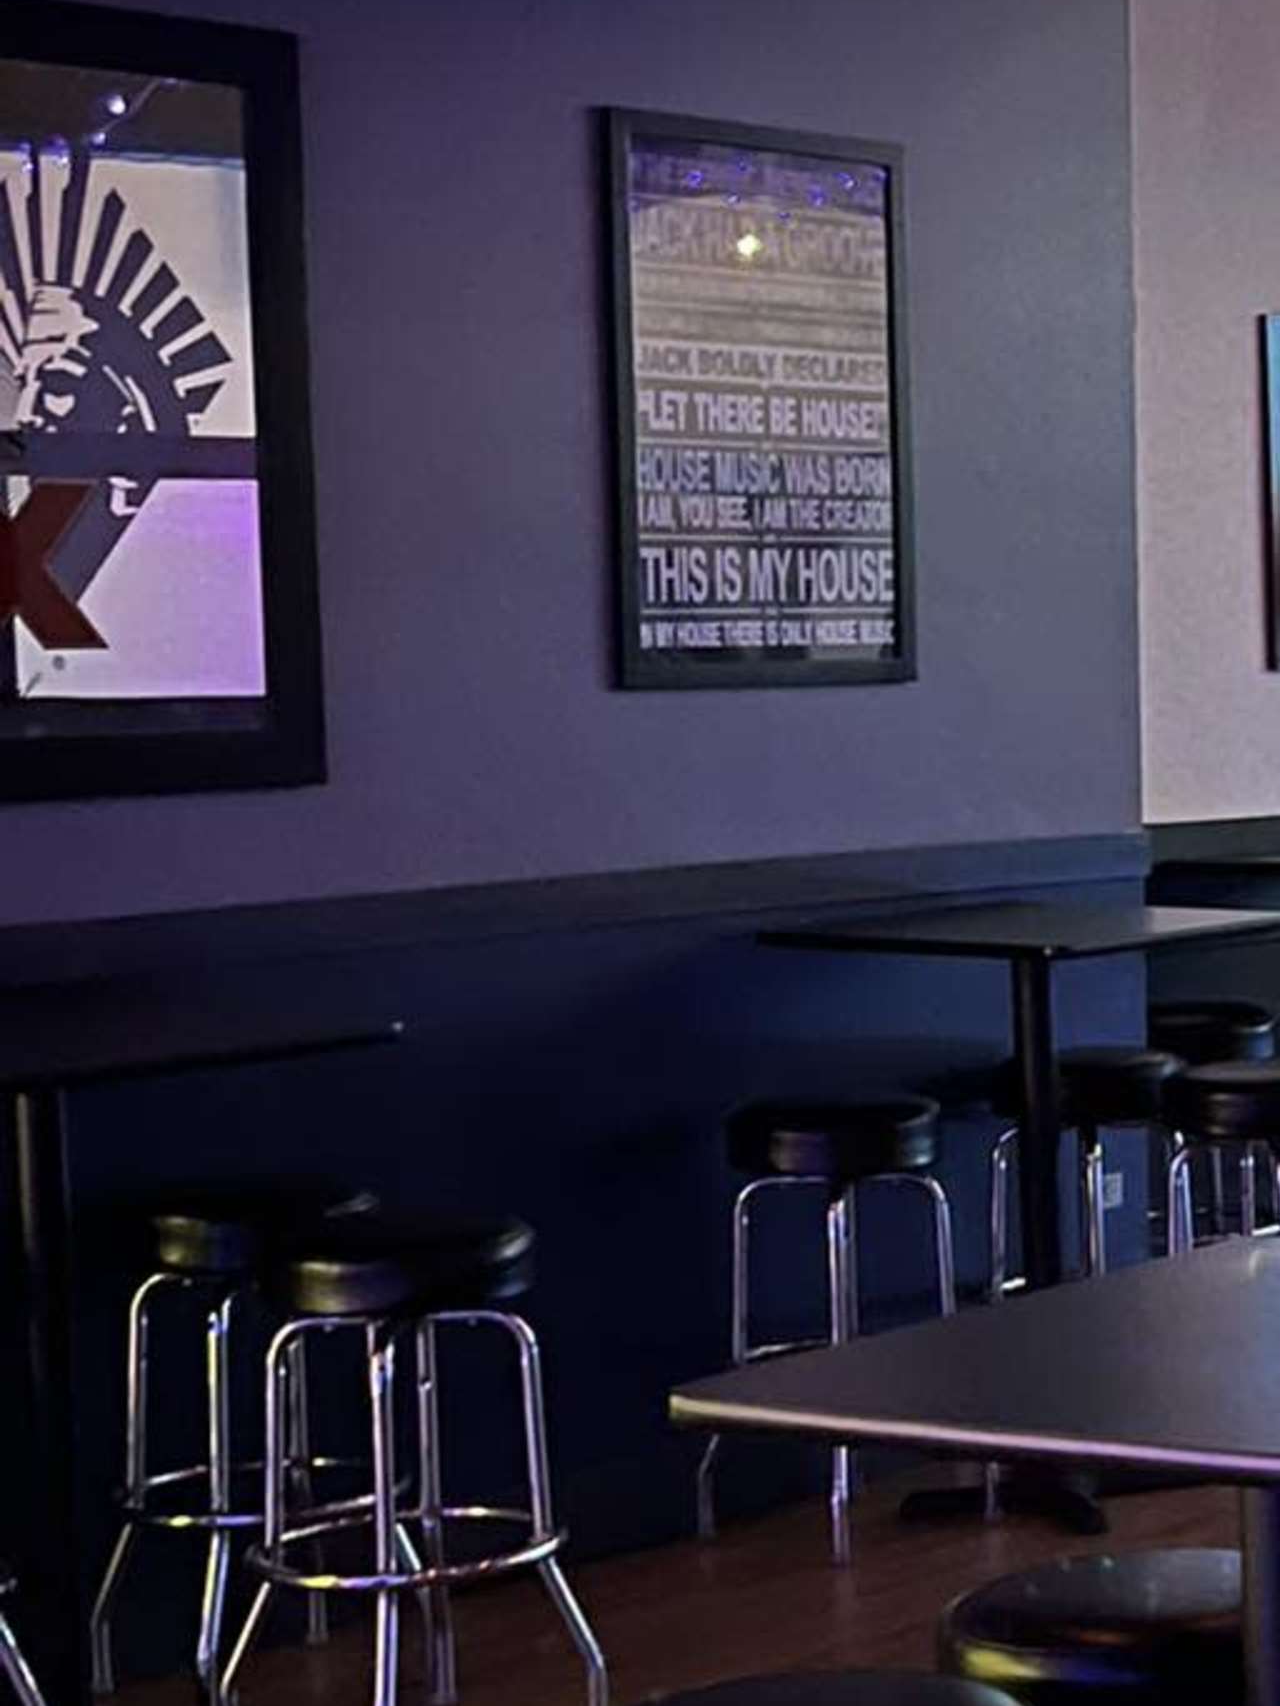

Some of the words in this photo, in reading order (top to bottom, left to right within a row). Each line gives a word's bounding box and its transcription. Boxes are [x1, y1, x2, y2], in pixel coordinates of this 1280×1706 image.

[640, 344, 693, 374] JACK
[693, 392, 765, 435] THERE
[768, 395, 798, 436] BE
[638, 450, 711, 492] HOUSE
[715, 452, 781, 494] MUSIC
[783, 455, 831, 495] WAS
[834, 456, 891, 496] BORN
[640, 546, 709, 603] THIS
[715, 547, 743, 603] IS
[749, 548, 792, 603] MY
[798, 548, 895, 603] HOUSE
